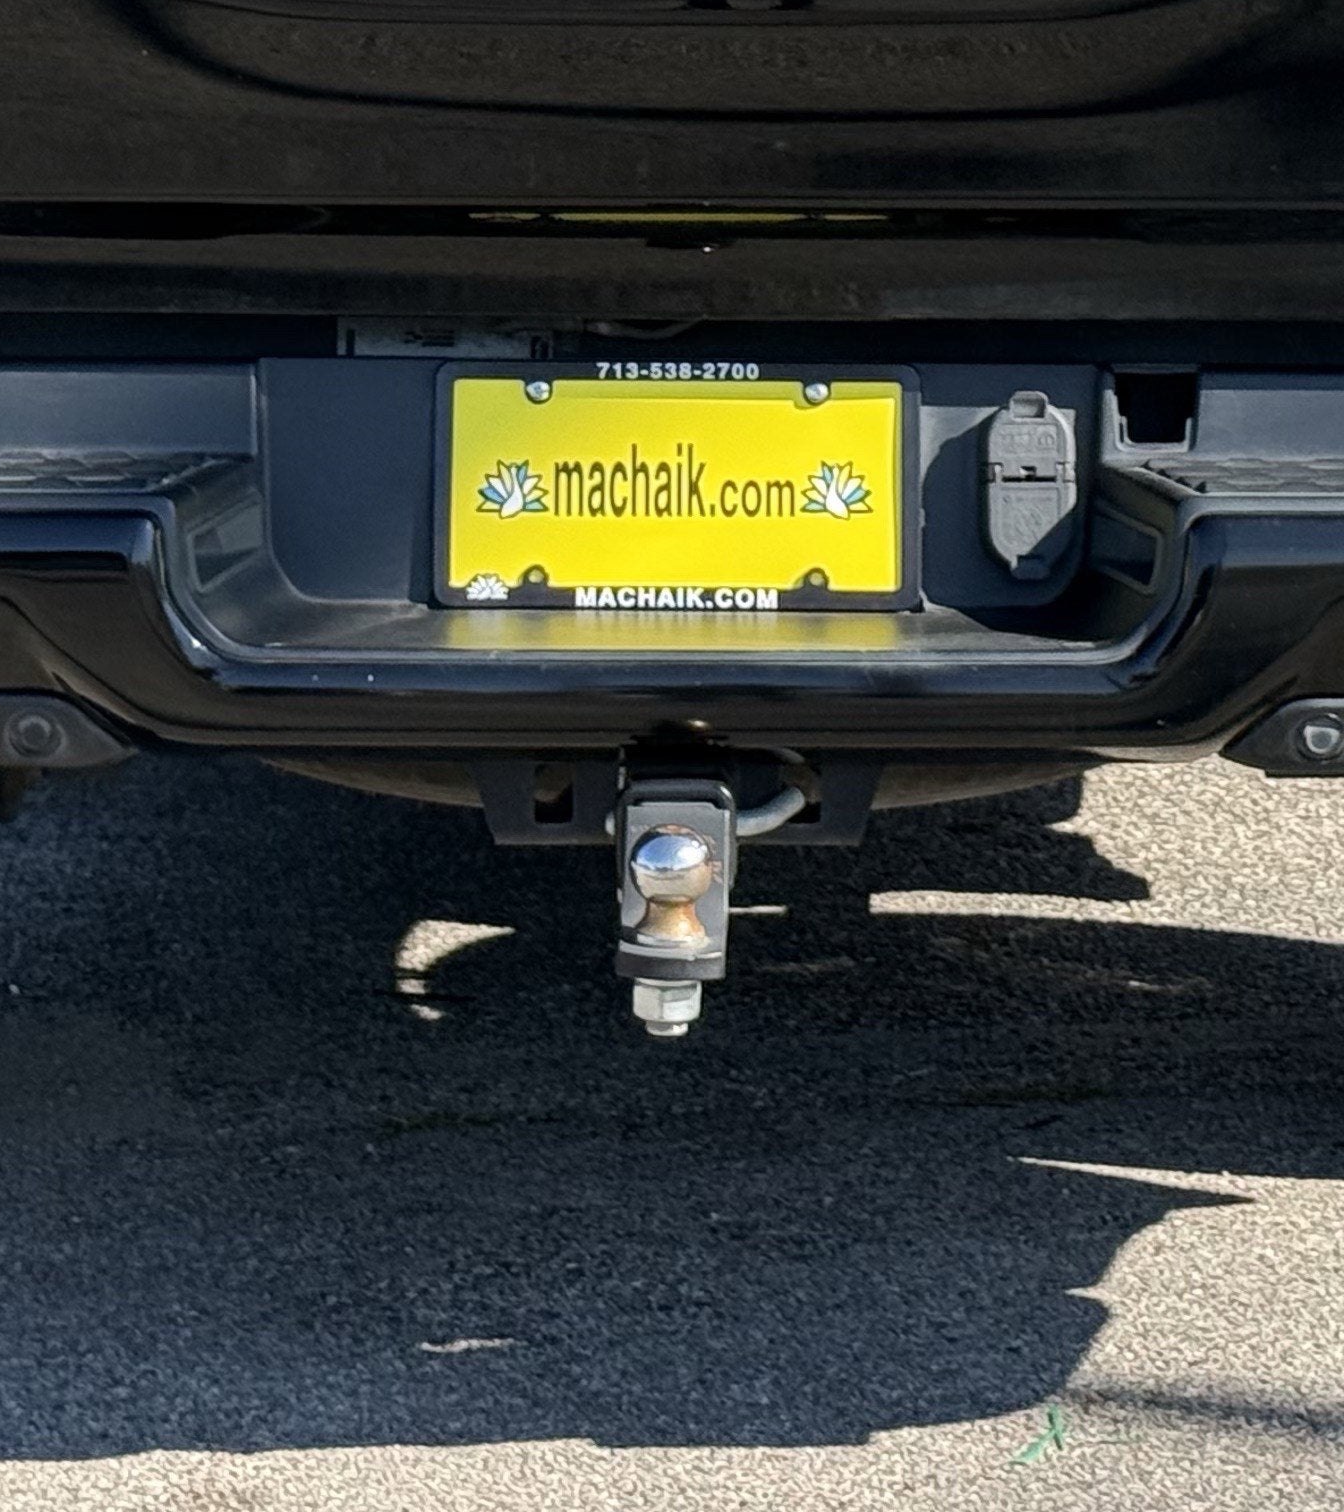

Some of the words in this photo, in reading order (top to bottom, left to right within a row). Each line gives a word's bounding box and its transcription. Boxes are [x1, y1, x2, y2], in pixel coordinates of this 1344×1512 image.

[596, 362, 760, 380] 713-538-2700
[554, 443, 795, 517] machaik.com
[575, 586, 779, 610] MACHAIK.COM
